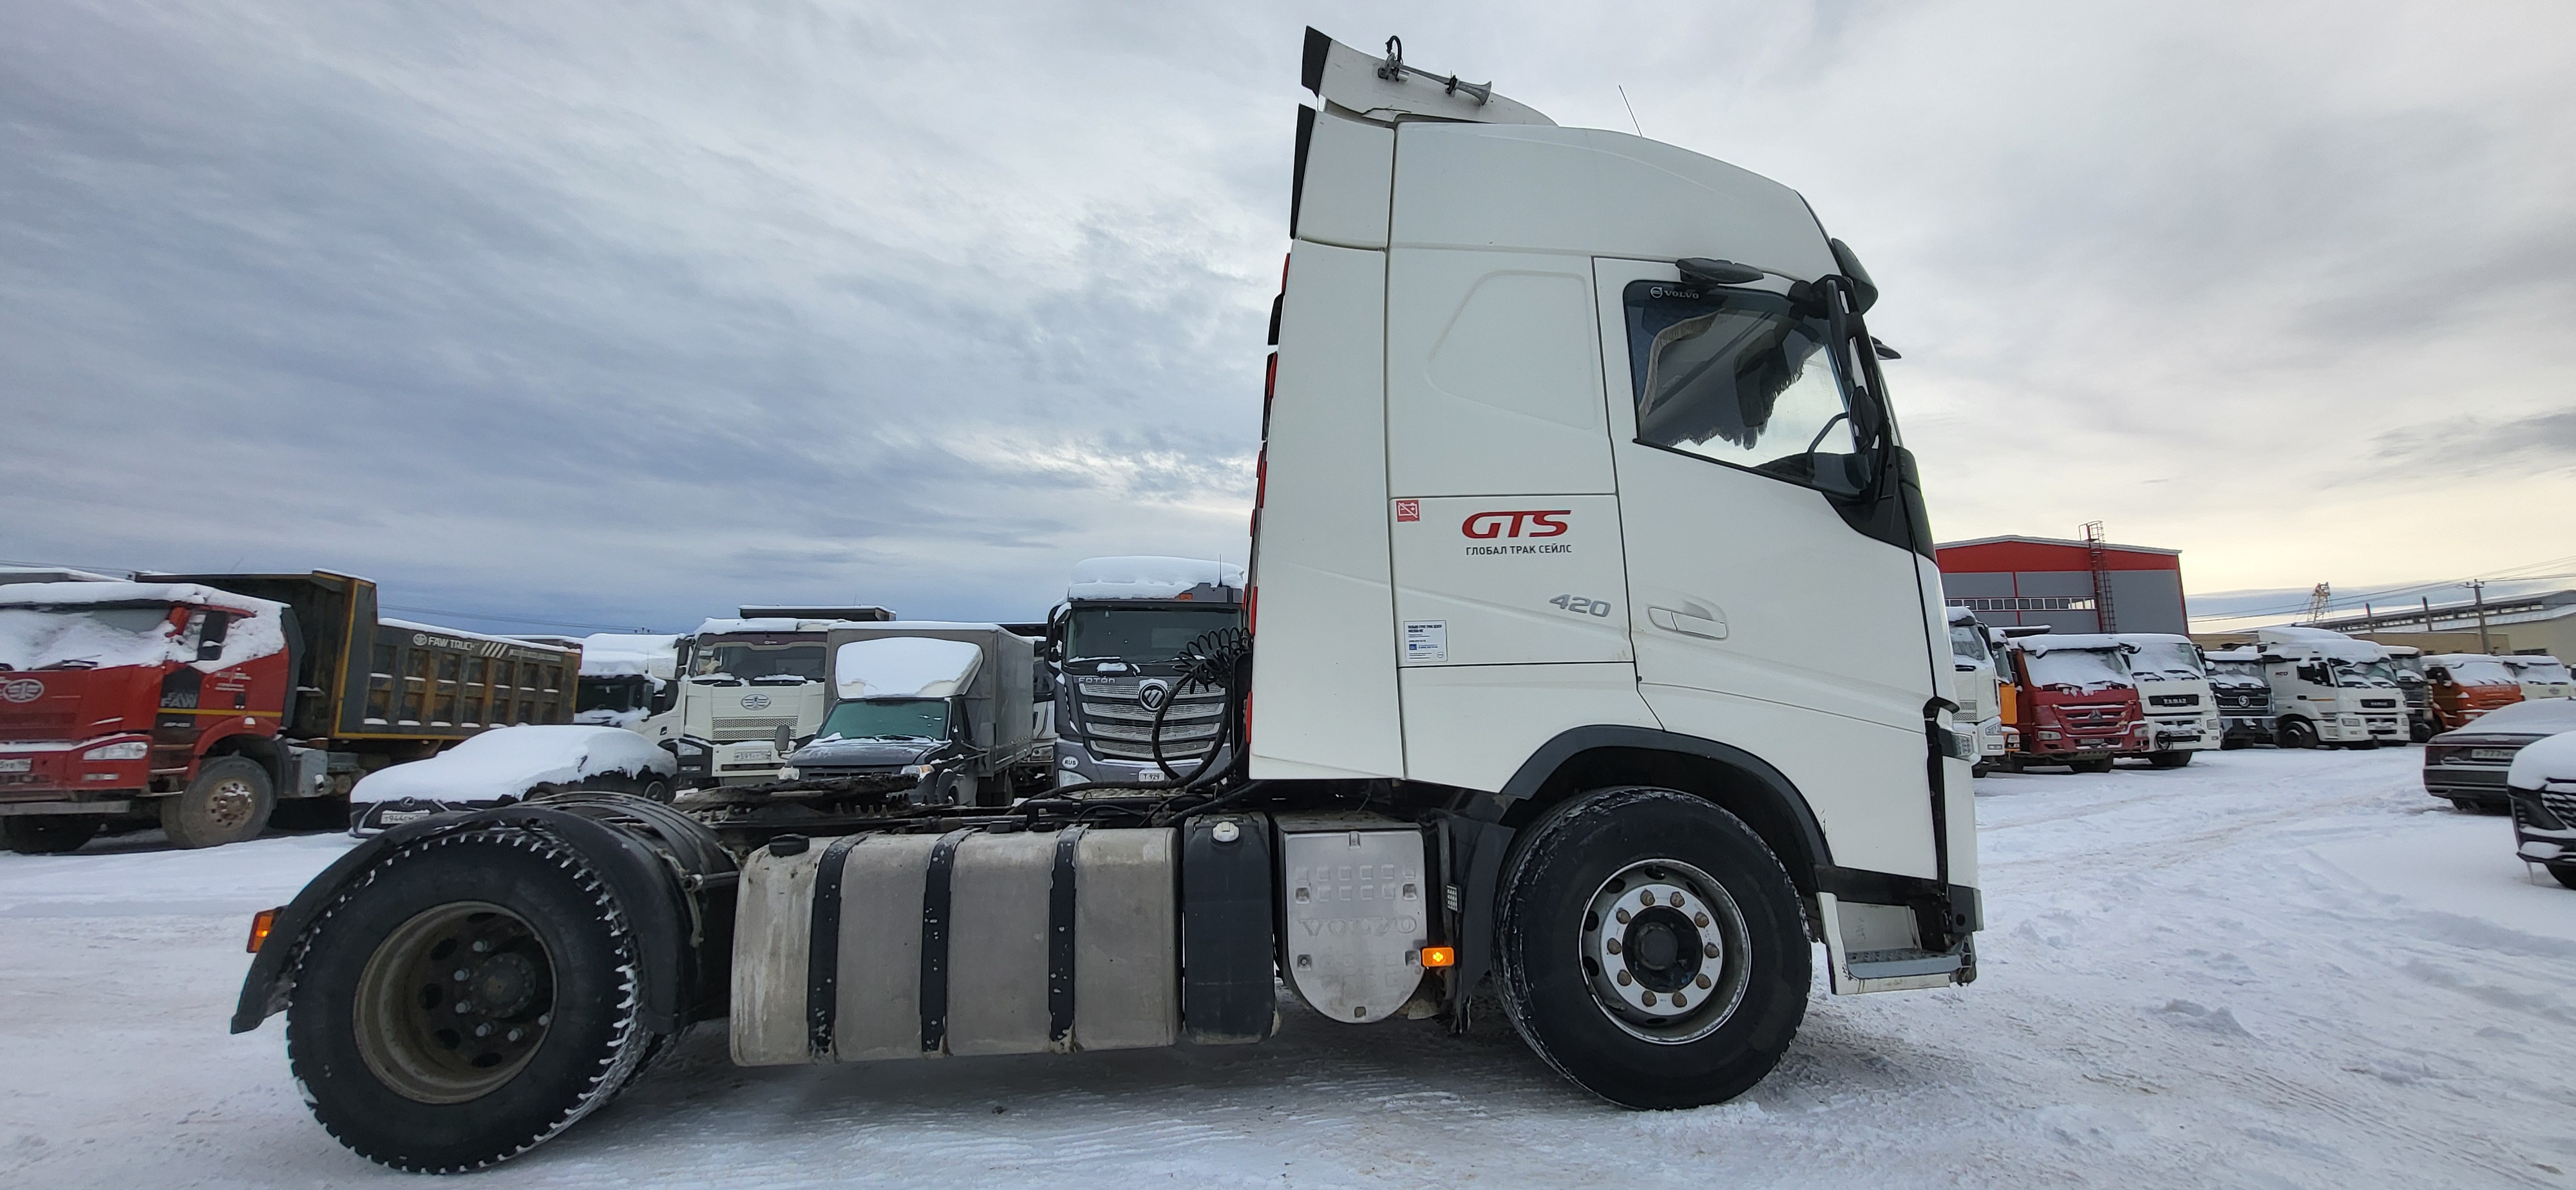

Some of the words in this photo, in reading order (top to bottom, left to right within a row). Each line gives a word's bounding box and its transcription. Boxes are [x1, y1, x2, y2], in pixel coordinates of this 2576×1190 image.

[1663, 290, 1699, 299] VOLVO
[1462, 509, 1571, 538] GTS
[1466, 546, 1507, 555] ГЛОБАЛ
[1510, 545, 1536, 554] ТРАК
[1539, 543, 1572, 553] СЕЙЛС
[1549, 594, 1611, 618] 420
[427, 636, 449, 647] FAW
[1296, 915, 1417, 937] VOLVO
